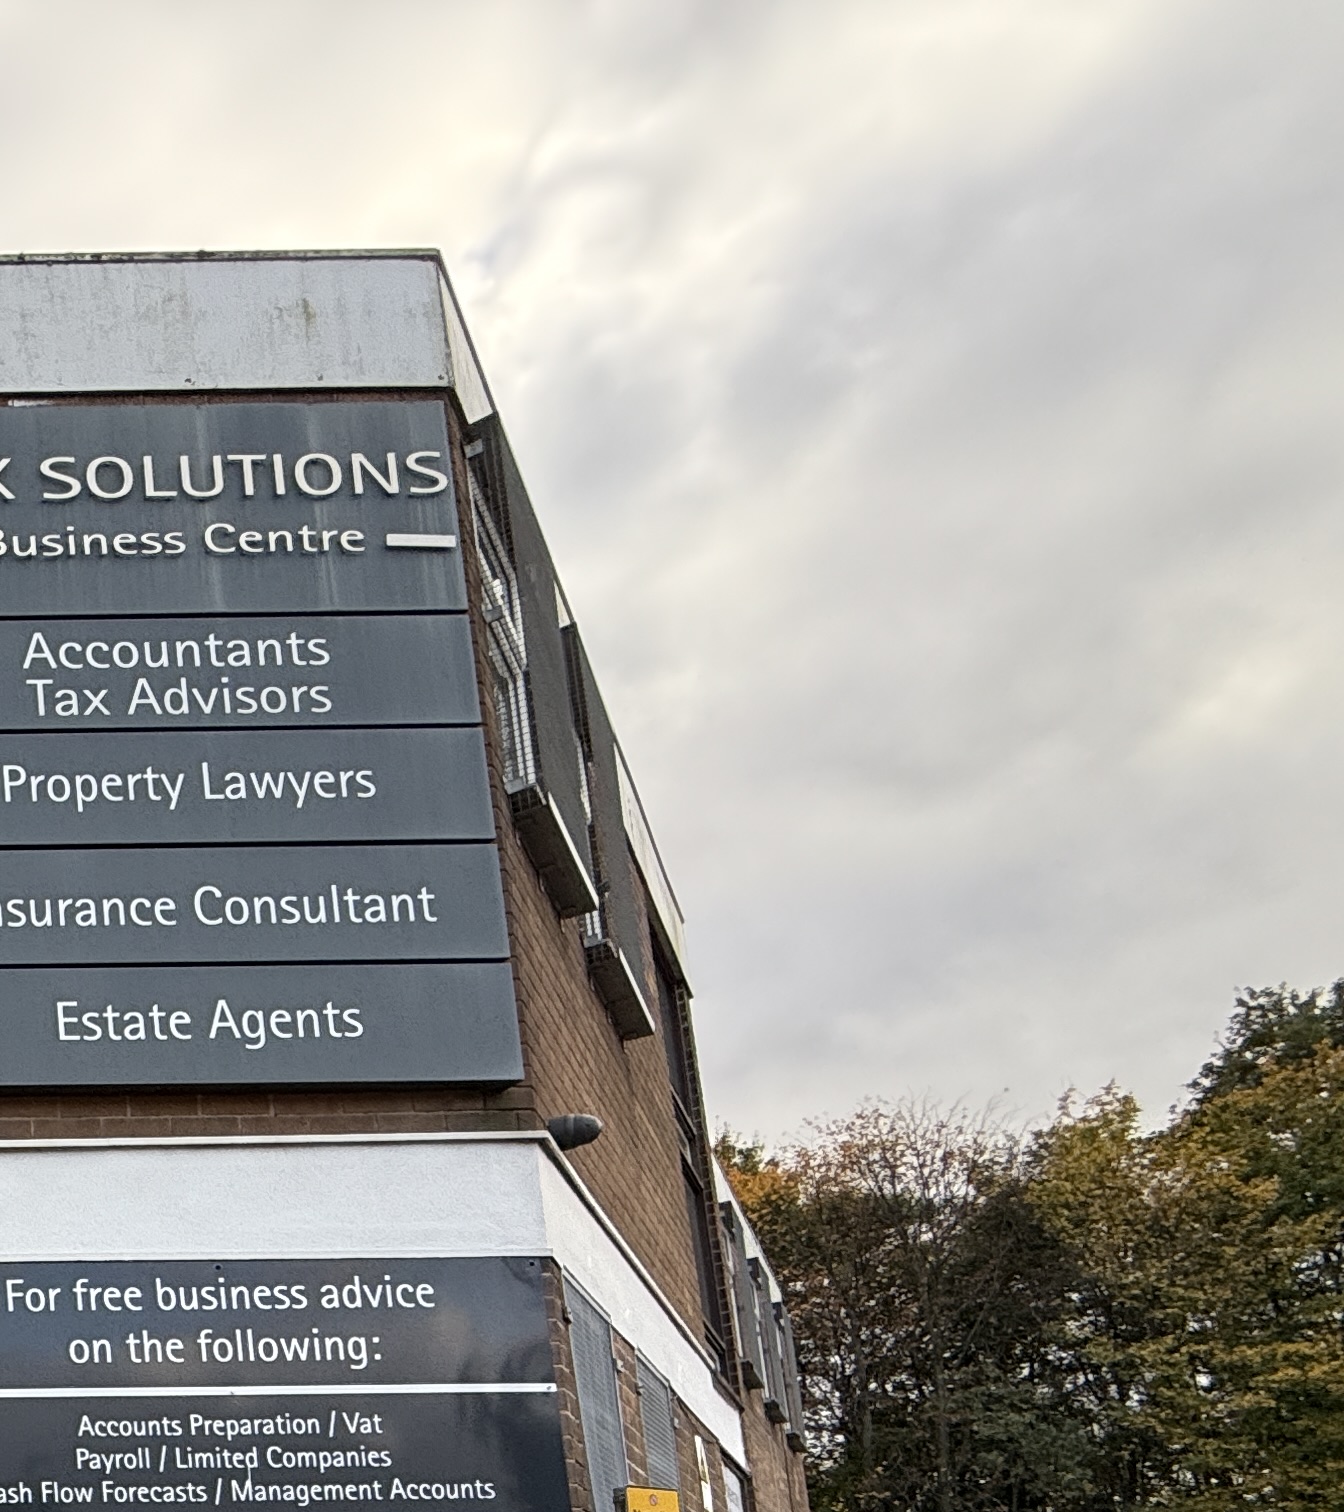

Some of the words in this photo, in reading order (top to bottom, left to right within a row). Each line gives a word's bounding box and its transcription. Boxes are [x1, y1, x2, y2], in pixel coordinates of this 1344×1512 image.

[40, 451, 448, 499] SOLUTIONS
[205, 523, 365, 552] Centre
[23, 632, 330, 669] Accountants
[26, 679, 110, 716] Tax
[128, 677, 332, 715] Advisors
[3, 765, 184, 812] Property
[202, 762, 376, 808] Lawyers
[194, 885, 437, 925] Consultant
[57, 1001, 192, 1040] Estate
[209, 1000, 363, 1049] Agents
[6, 1279, 61, 1312] For
[73, 1279, 142, 1311] free
[156, 1278, 307, 1310] business
[320, 1275, 435, 1308] advice
[69, 1340, 112, 1363] on
[126, 1330, 184, 1363] the
[197, 1328, 381, 1369] following:
[78, 1415, 182, 1436] Accounts
[190, 1413, 320, 1441] Preparation
[329, 1410, 336, 1437] /
[342, 1412, 383, 1433] Vat
[76, 1448, 150, 1474] Payroll
[159, 1445, 166, 1472] /
[176, 1447, 258, 1470] Limited
[267, 1445, 392, 1473] Companies
[42, 1482, 93, 1503] Flow
[102, 1481, 207, 1502] Forecasts
[215, 1478, 222, 1505] /
[231, 1476, 383, 1506] Management
[390, 1478, 495, 1499] Accounts
